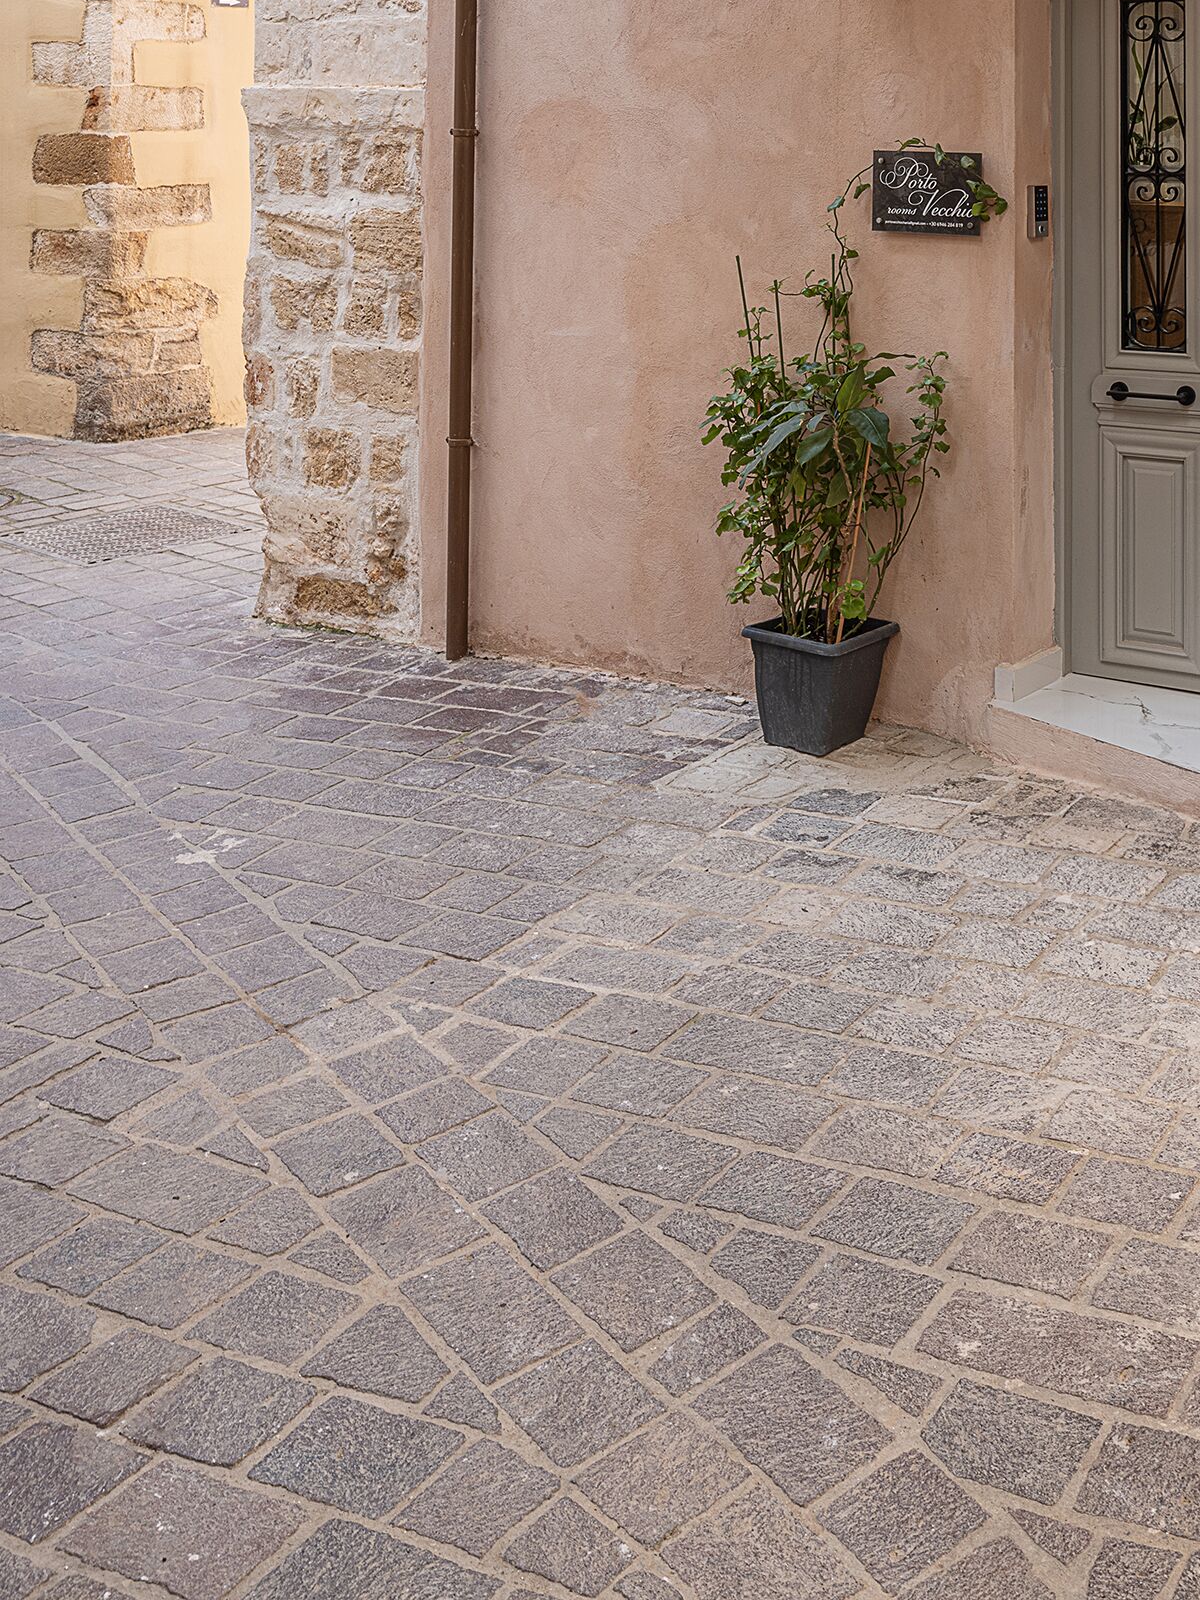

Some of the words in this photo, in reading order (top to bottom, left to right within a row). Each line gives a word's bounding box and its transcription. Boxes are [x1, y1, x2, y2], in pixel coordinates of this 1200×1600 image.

[879, 156, 938, 189] Porto
[887, 207, 917, 216] rooms
[908, 188, 975, 218] Vecchio
